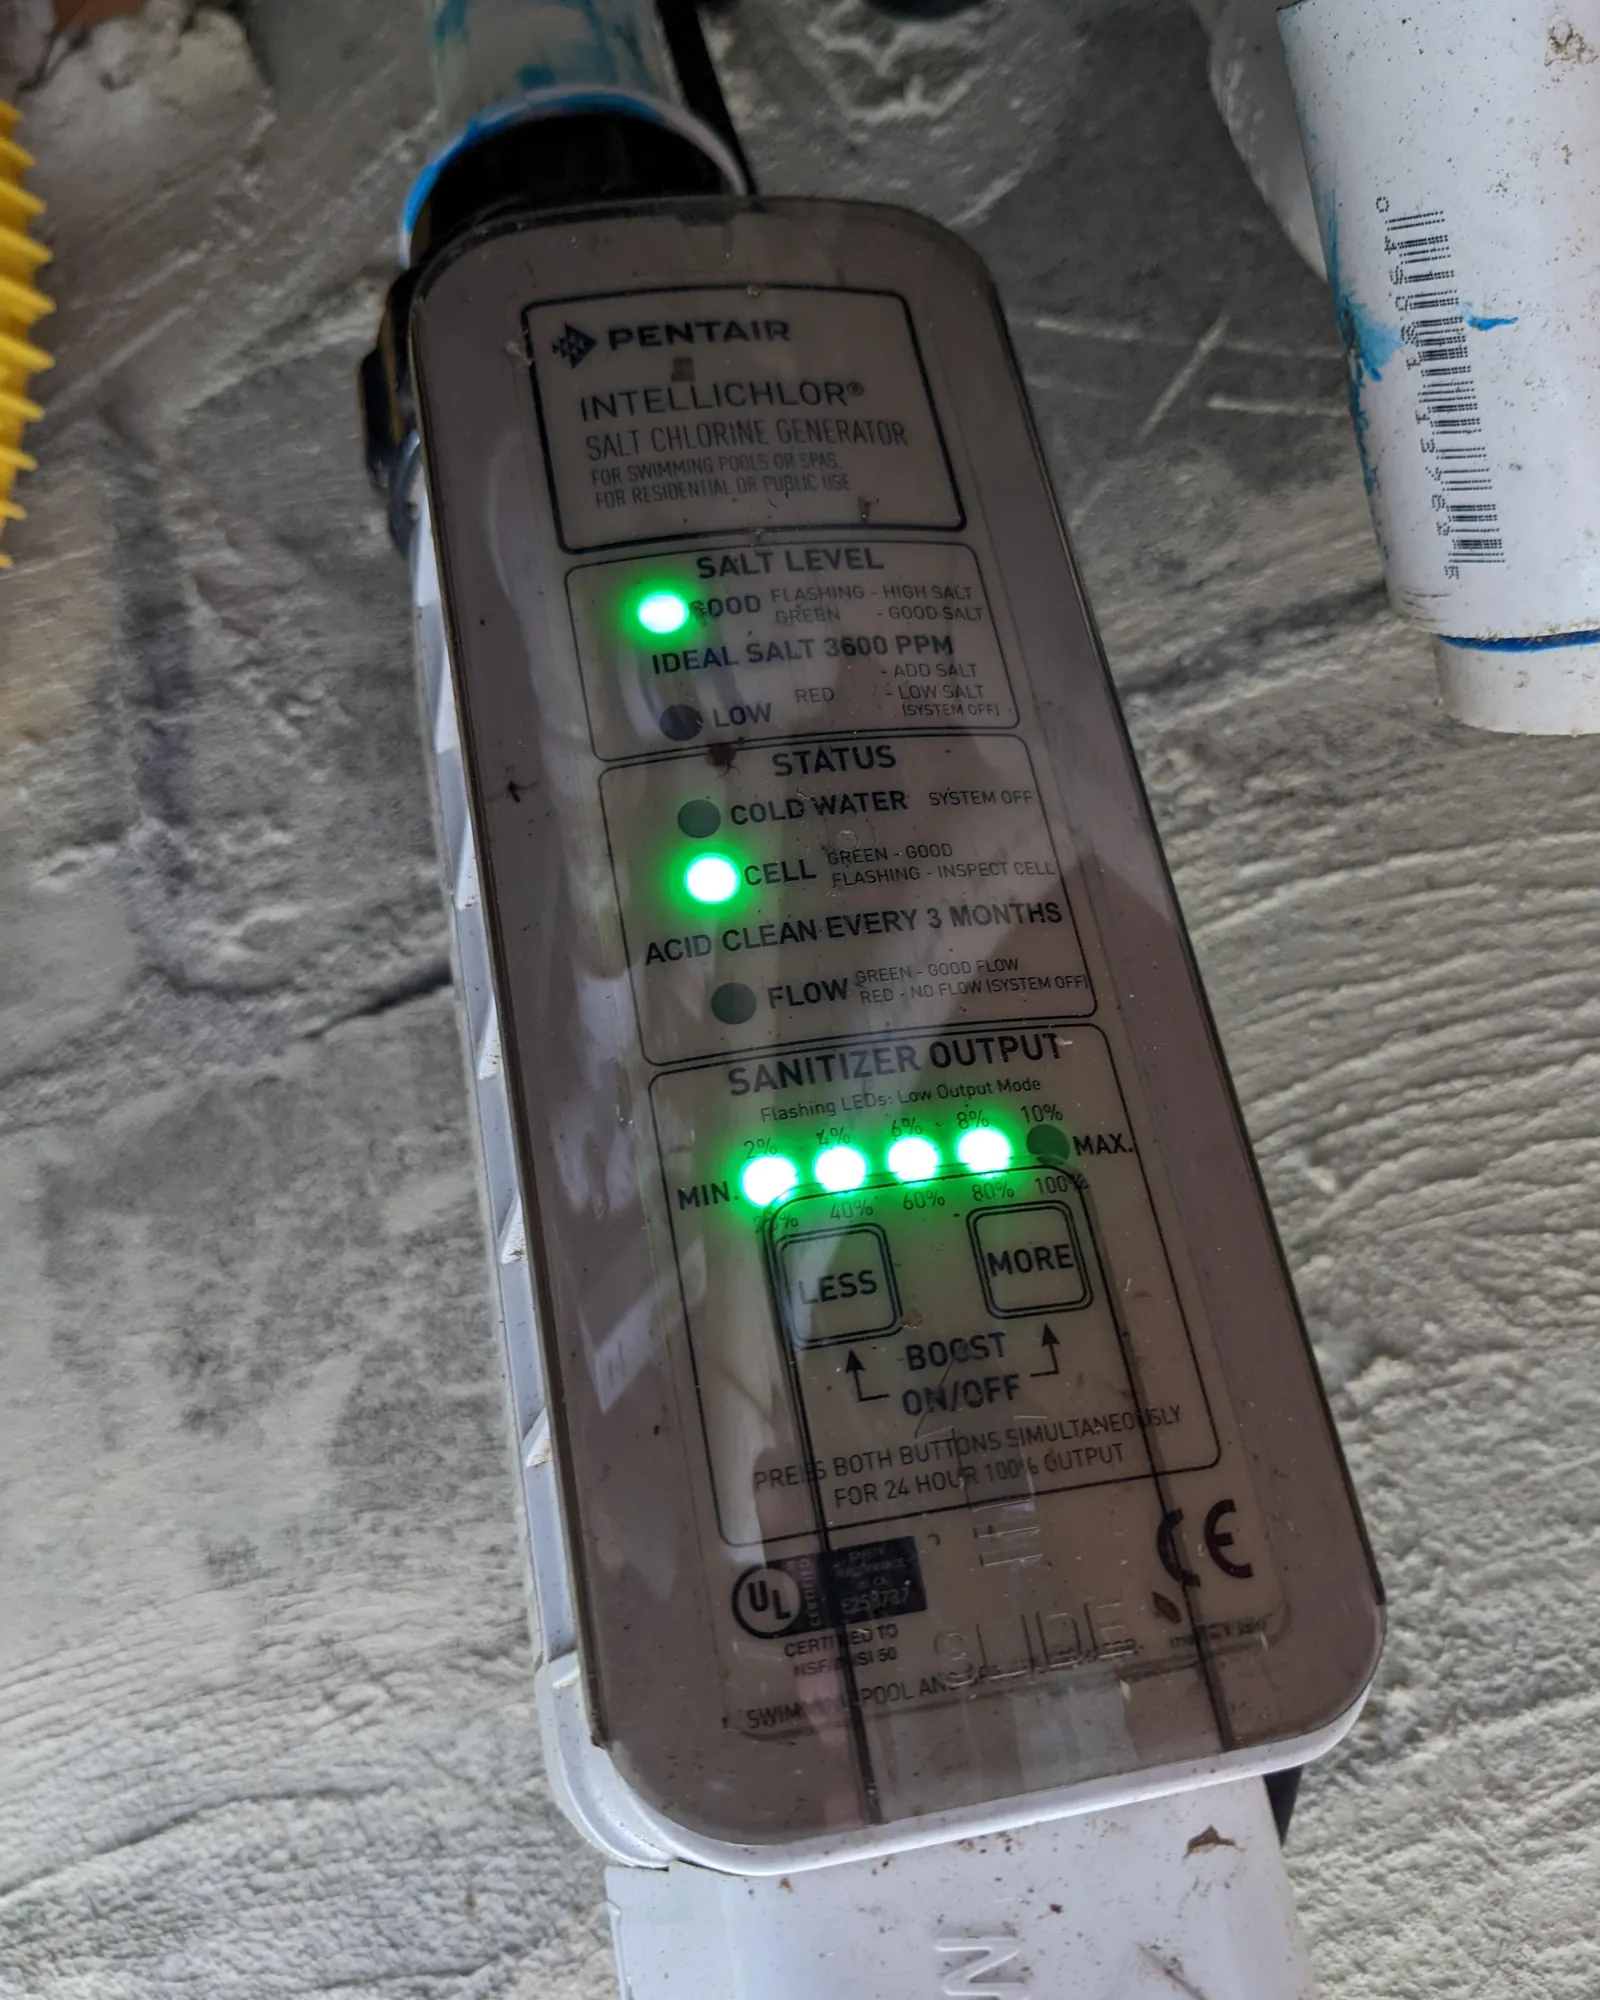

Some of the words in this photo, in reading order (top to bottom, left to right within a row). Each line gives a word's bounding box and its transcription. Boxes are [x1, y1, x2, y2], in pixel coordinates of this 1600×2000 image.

[608, 319, 790, 351] PENTAIR
[586, 429, 639, 461] SALT
[652, 419, 769, 453] CHLORINE
[777, 418, 907, 447] GENERATOR
[591, 467, 622, 487] FOR
[628, 458, 713, 483] SWIMMING
[719, 454, 769, 472] POOLS
[774, 453, 795, 469] OR
[596, 490, 627, 509] FOR
[633, 478, 731, 506] RESIDENTIAL
[736, 476, 756, 494] OR
[764, 474, 816, 493] PUBLIC
[822, 474, 852, 491] USE
[697, 552, 773, 579] SALT
[786, 548, 884, 572] LEVEL
[771, 585, 865, 602] FLASHING
[883, 586, 929, 600] HIGH
[933, 586, 972, 600] SALT
[775, 607, 840, 624] GREEN
[888, 607, 938, 621] GOOD
[942, 607, 983, 622] SALT
[652, 645, 739, 675] IDEAL
[746, 639, 814, 665] SALT
[825, 636, 888, 657] 3600
[894, 636, 953, 655] PPM
[894, 663, 930, 678] ADD
[935, 663, 976, 678] SALT
[796, 688, 834, 703] RED
[899, 685, 939, 700] LOW
[944, 684, 984, 699] SALT
[713, 704, 771, 729] LOW
[773, 745, 897, 777] STATUS
[731, 800, 803, 825] COLD
[814, 791, 907, 816] WATER
[928, 791, 996, 806] SYSTEM
[1000, 790, 1033, 804] OFF
[827, 848, 888, 865] GREEN
[906, 843, 953, 858] GOOD
[745, 859, 816, 886] CELL
[832, 867, 921, 888] FLASHING
[938, 861, 1007, 878] INSPECT
[1014, 860, 1055, 875] CELL
[645, 935, 712, 966] ACID
[722, 920, 816, 951] CLEAN
[825, 909, 917, 938] EVERY
[927, 909, 942, 929] 3
[950, 903, 1062, 928] MONTHS
[855, 967, 912, 986] GREEN
[927, 961, 972, 977] GOOD
[977, 958, 1018, 974] FLOW
[768, 978, 849, 1009] FLOW
[860, 989, 893, 1004] RED
[911, 984, 933, 998] NO
[938, 979, 981, 995] FLOW
[727, 1045, 920, 1096] SANITIZER
[928, 1034, 1063, 1068] OUTPUT
[761, 1099, 837, 1124] Flashing
[897, 1087, 932, 1105] Low
[937, 1081, 993, 1103] Output
[997, 1077, 1041, 1094] Mode
[744, 1138, 778, 1158] 2%
[815, 1127, 851, 1146] 4%
[890, 1116, 922, 1136] 6%
[956, 1110, 989, 1129] 8%
[1021, 1104, 1063, 1124] 10%
[1073, 1134, 1134, 1156] MAX.
[678, 1181, 739, 1210] MIN.
[829, 1199, 874, 1221] 40%
[903, 1191, 945, 1211] 60%
[971, 1182, 1014, 1202] 80%
[1035, 1174, 1089, 1195] 100%
[985, 1244, 1074, 1278] MORE
[799, 1270, 878, 1307] LESS
[906, 1331, 1008, 1372] BOOST
[901, 1374, 1022, 1417] ON/OFF
[754, 1460, 827, 1491] PRES
[833, 1450, 894, 1477] BOTH
[900, 1432, 1000, 1465] BUTTONS
[1006, 1404, 1181, 1446] SIMULTANEOUSLY
[833, 1482, 879, 1509] FOR
[885, 1477, 910, 1500] 24
[915, 1462, 980, 1494] HOUR
[985, 1459, 1038, 1484] 100%
[1044, 1443, 1125, 1473] OUTPUT
[876, 1623, 899, 1640] TO
[878, 1647, 897, 1662] 50
[861, 1679, 913, 1708] POOL
